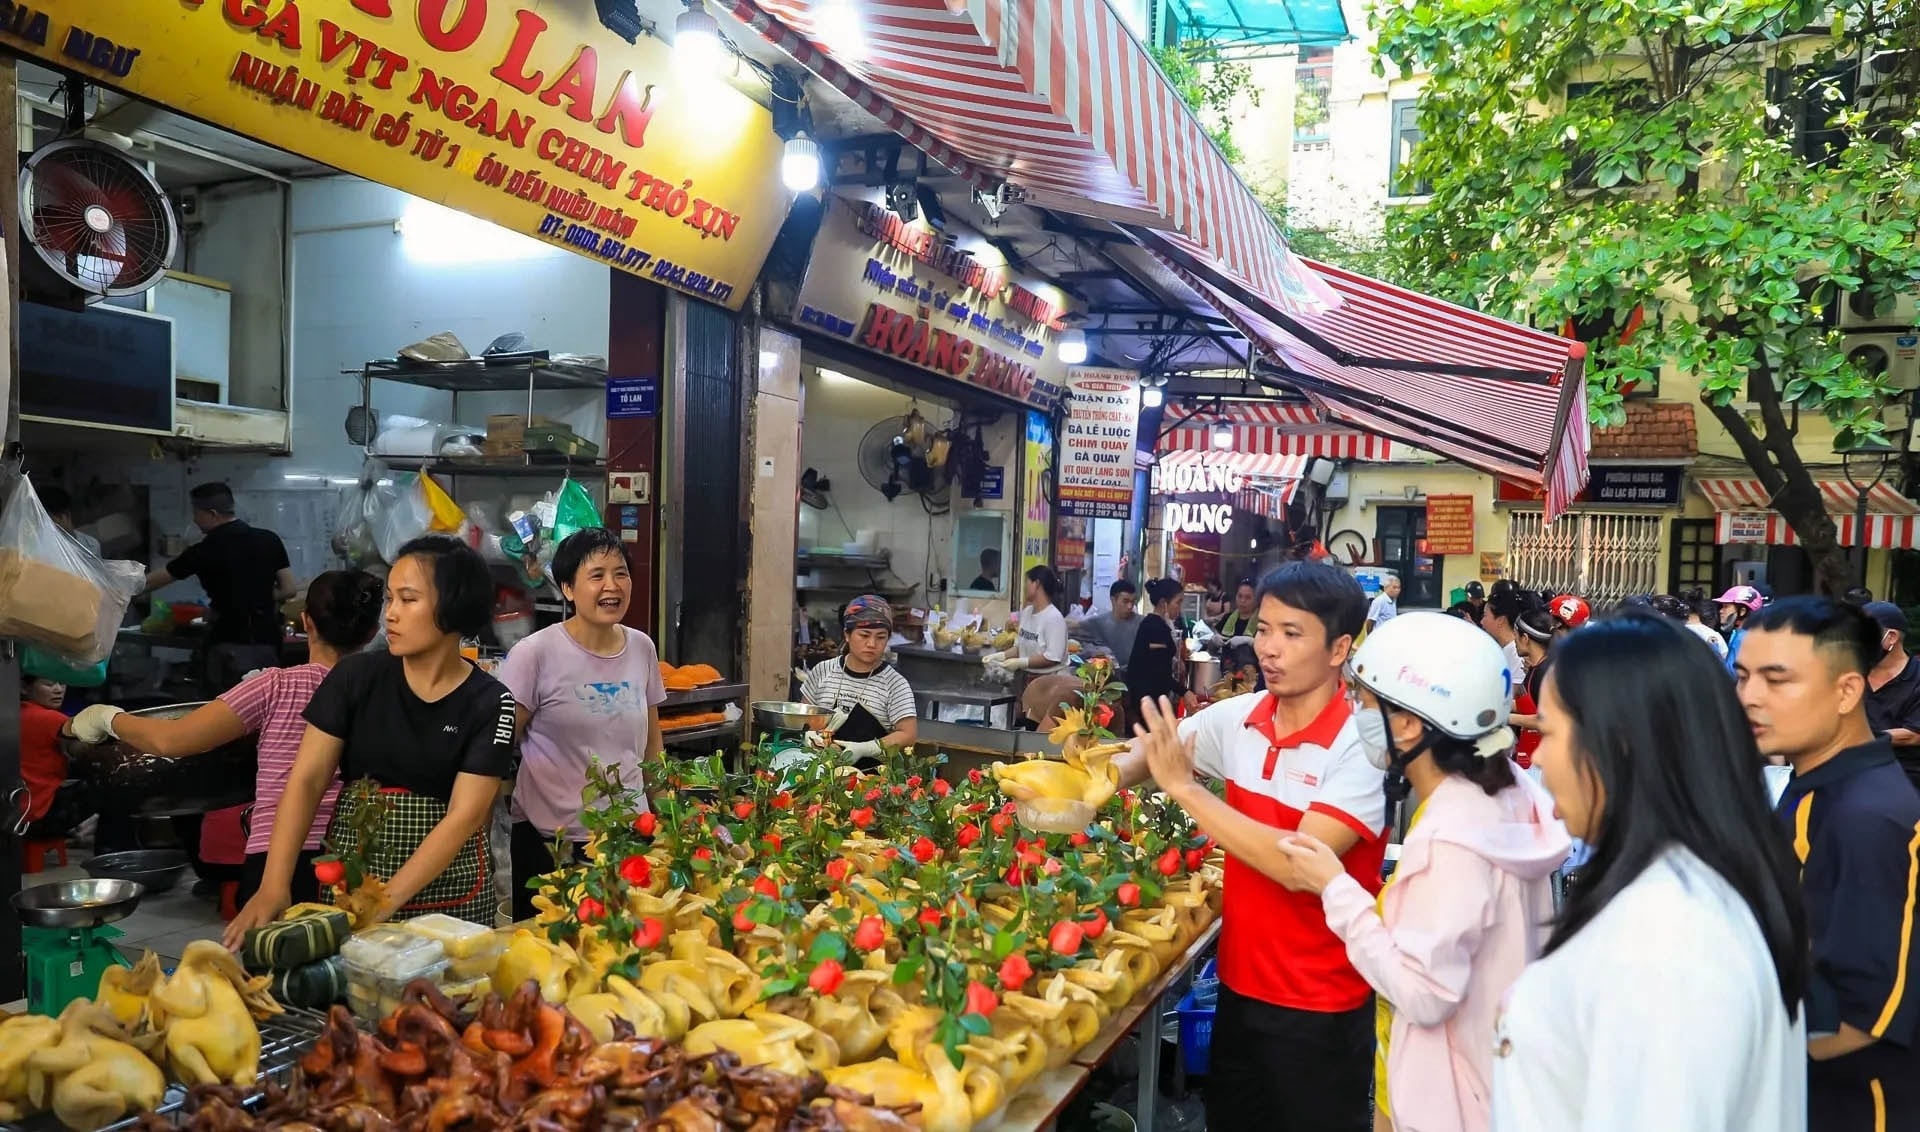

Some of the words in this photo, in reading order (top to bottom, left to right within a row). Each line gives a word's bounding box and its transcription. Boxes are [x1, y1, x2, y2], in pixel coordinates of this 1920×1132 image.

[490, 9, 656, 148] LAN
[318, 18, 409, 90] VỊT
[407, 66, 536, 149] NGAN
[537, 128, 627, 191] CHIM
[627, 178, 693, 219] THỎ
[683, 198, 741, 242] XỊN
[443, 143, 461, 168] 1
[864, 303, 974, 376] HOÀNG
[1068, 424, 1083, 434] GÀ
[1068, 438, 1098, 449] CHIM
[1101, 440, 1128, 451] QUAY
[1074, 451, 1089, 462] GÀ
[1093, 453, 1120, 463] QUAY
[1165, 502, 1233, 535] DUNG
